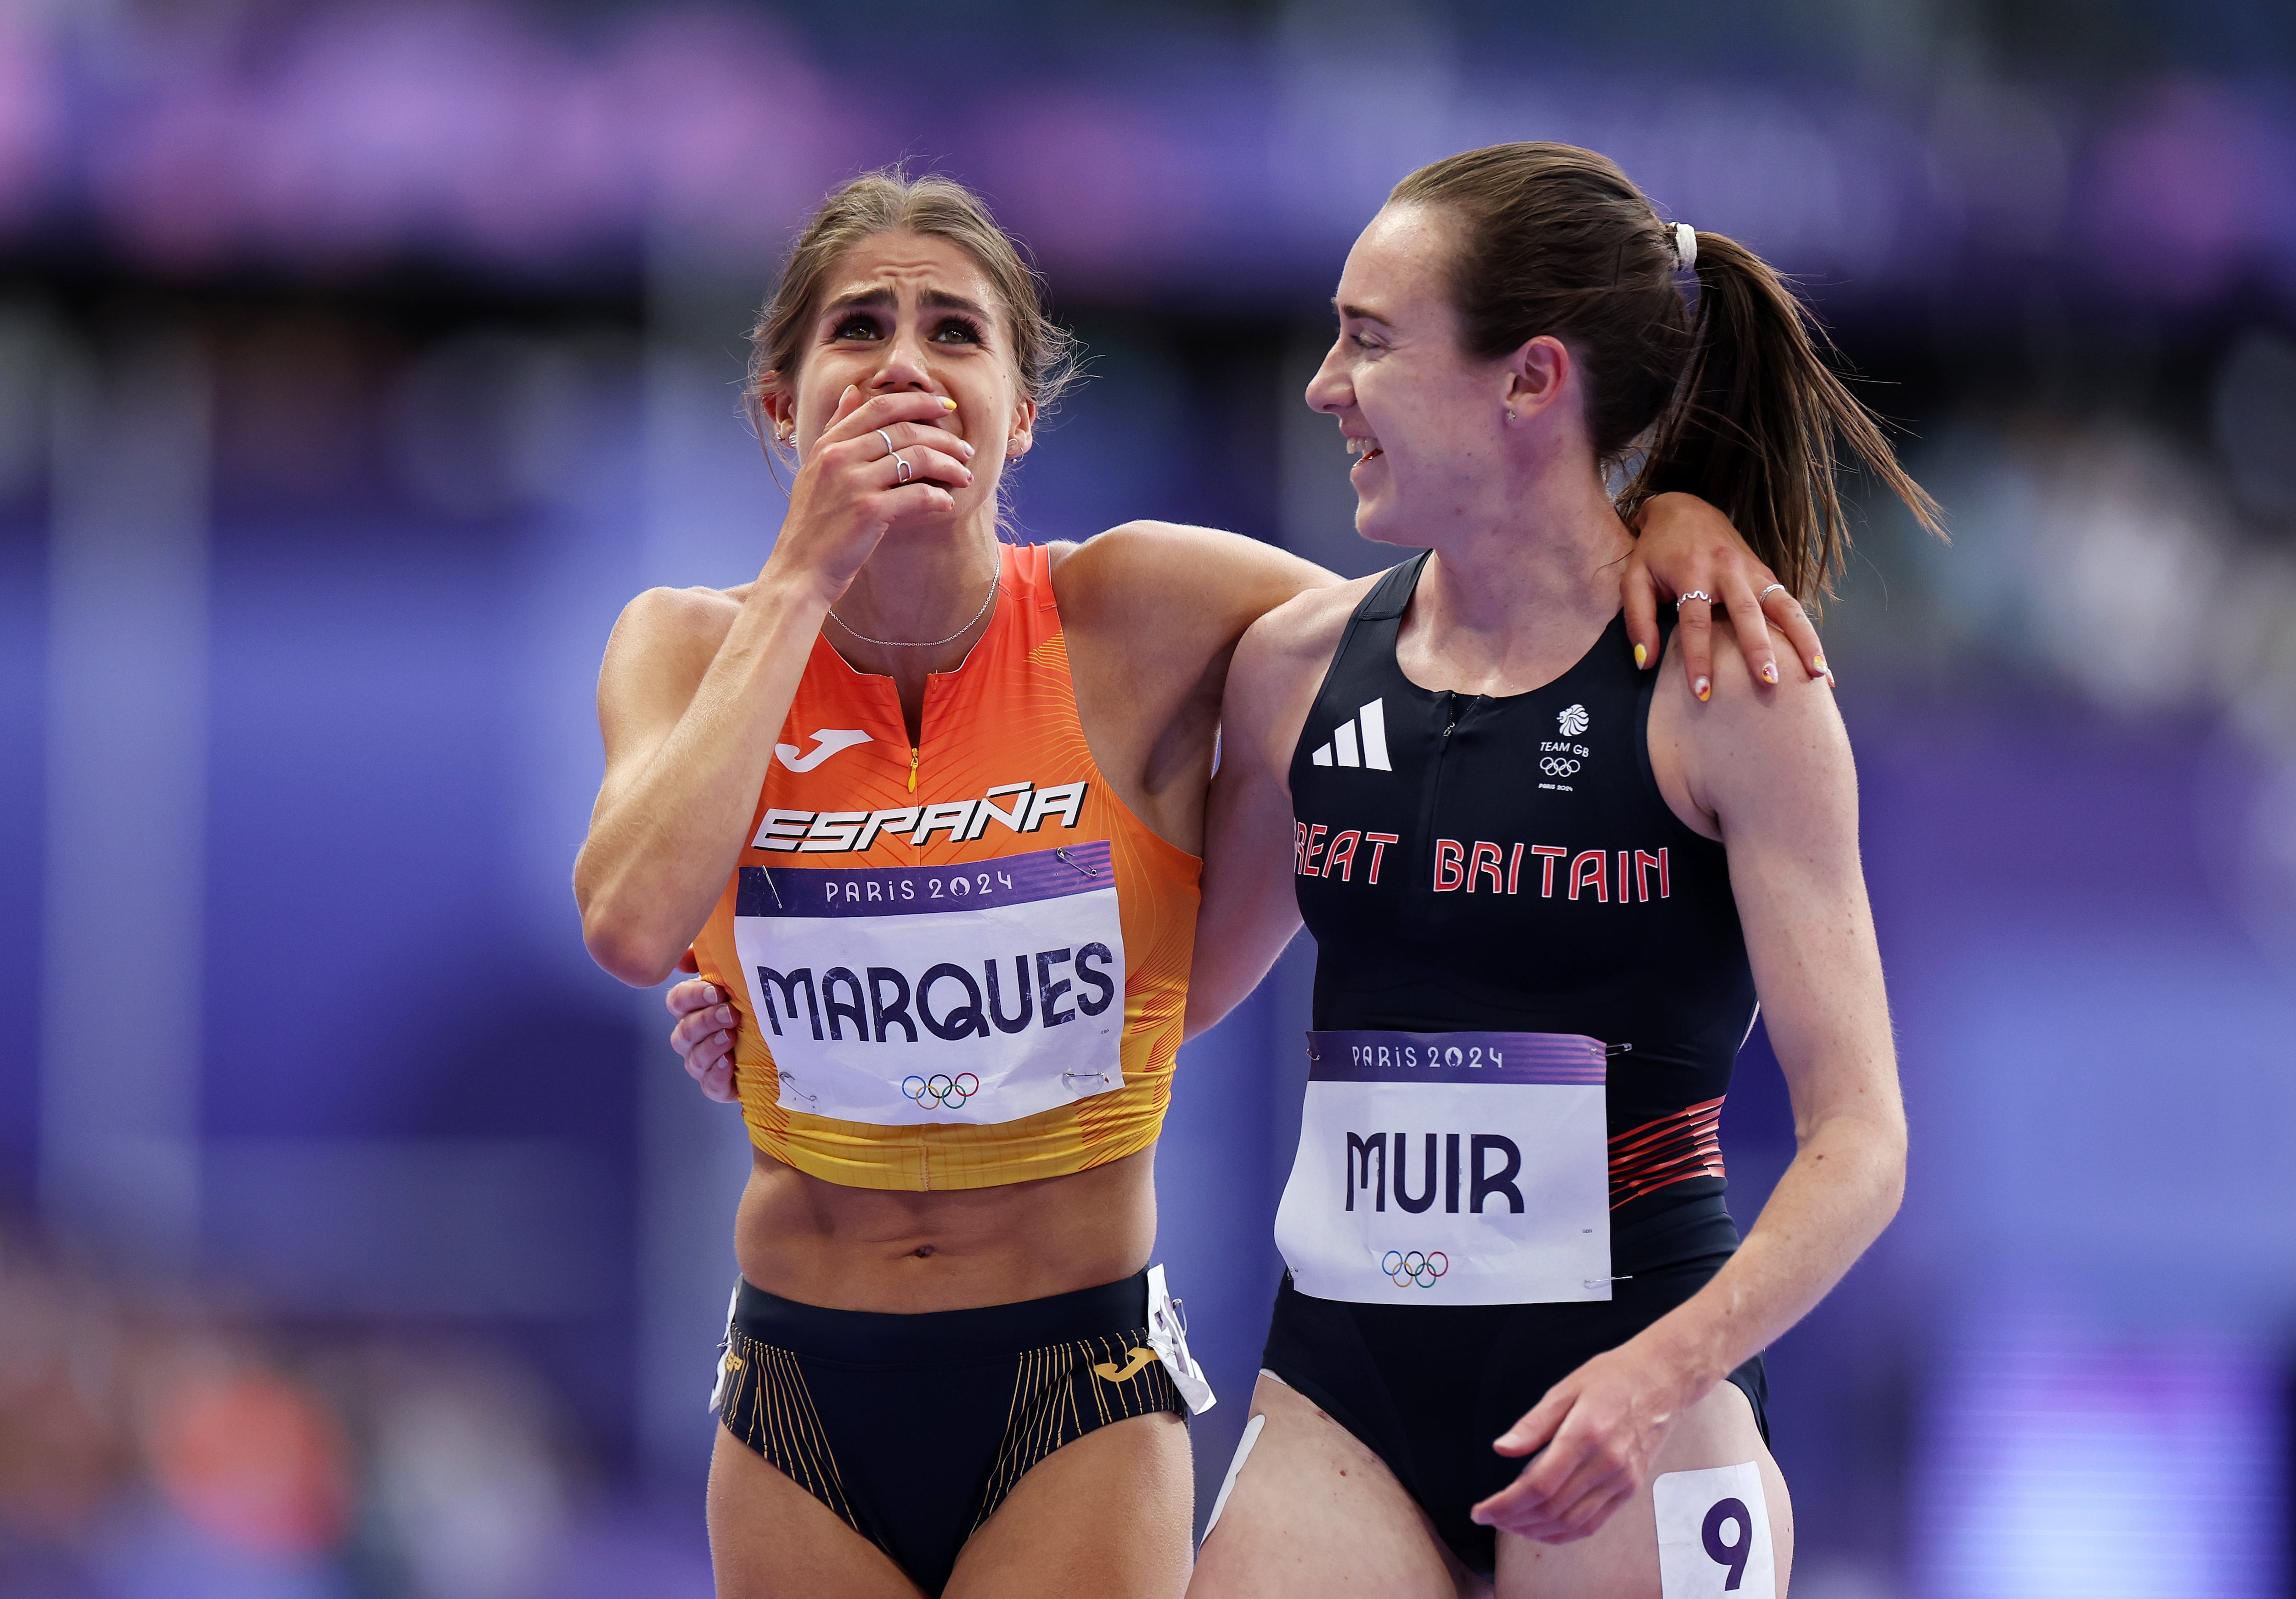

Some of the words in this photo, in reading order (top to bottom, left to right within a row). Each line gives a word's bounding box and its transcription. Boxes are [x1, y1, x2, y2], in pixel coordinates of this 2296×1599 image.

[1540, 741, 1571, 752] TEAM
[1573, 744, 1589, 757] GB
[751, 780, 1088, 853] ESPAÑA
[928, 871, 1012, 899] 2024
[1293, 816, 1400, 885] REAT
[1433, 838, 1671, 904] BRITAIN
[757, 942, 1114, 1043] MARQUES
[1427, 1046, 1503, 1068] 2024
[1345, 1132, 1525, 1214] MUIR
[1701, 1498, 1752, 1592] 9
